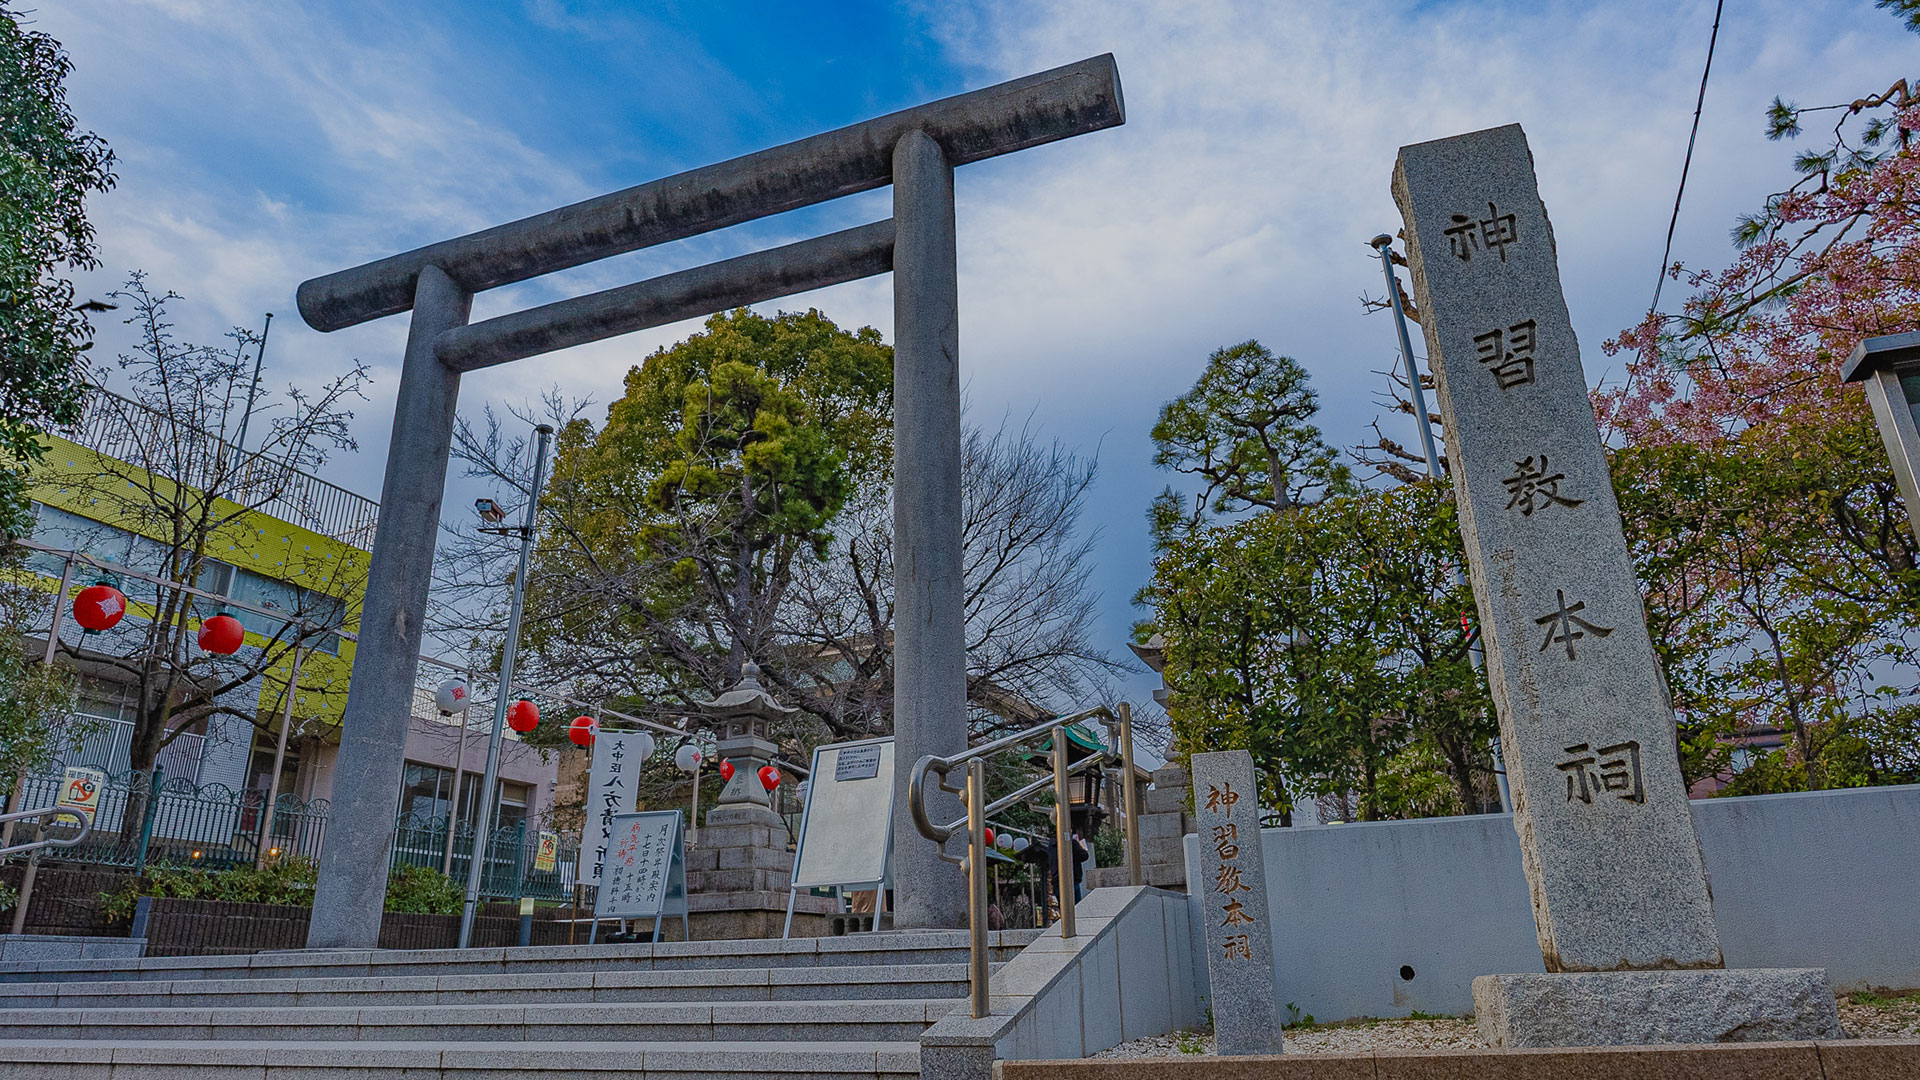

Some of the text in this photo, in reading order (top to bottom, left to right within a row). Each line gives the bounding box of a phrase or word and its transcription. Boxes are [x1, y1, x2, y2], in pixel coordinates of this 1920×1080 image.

[1443, 201, 1647, 804] 神習教本祠
[1204, 782, 1256, 961] 神習教本祠
